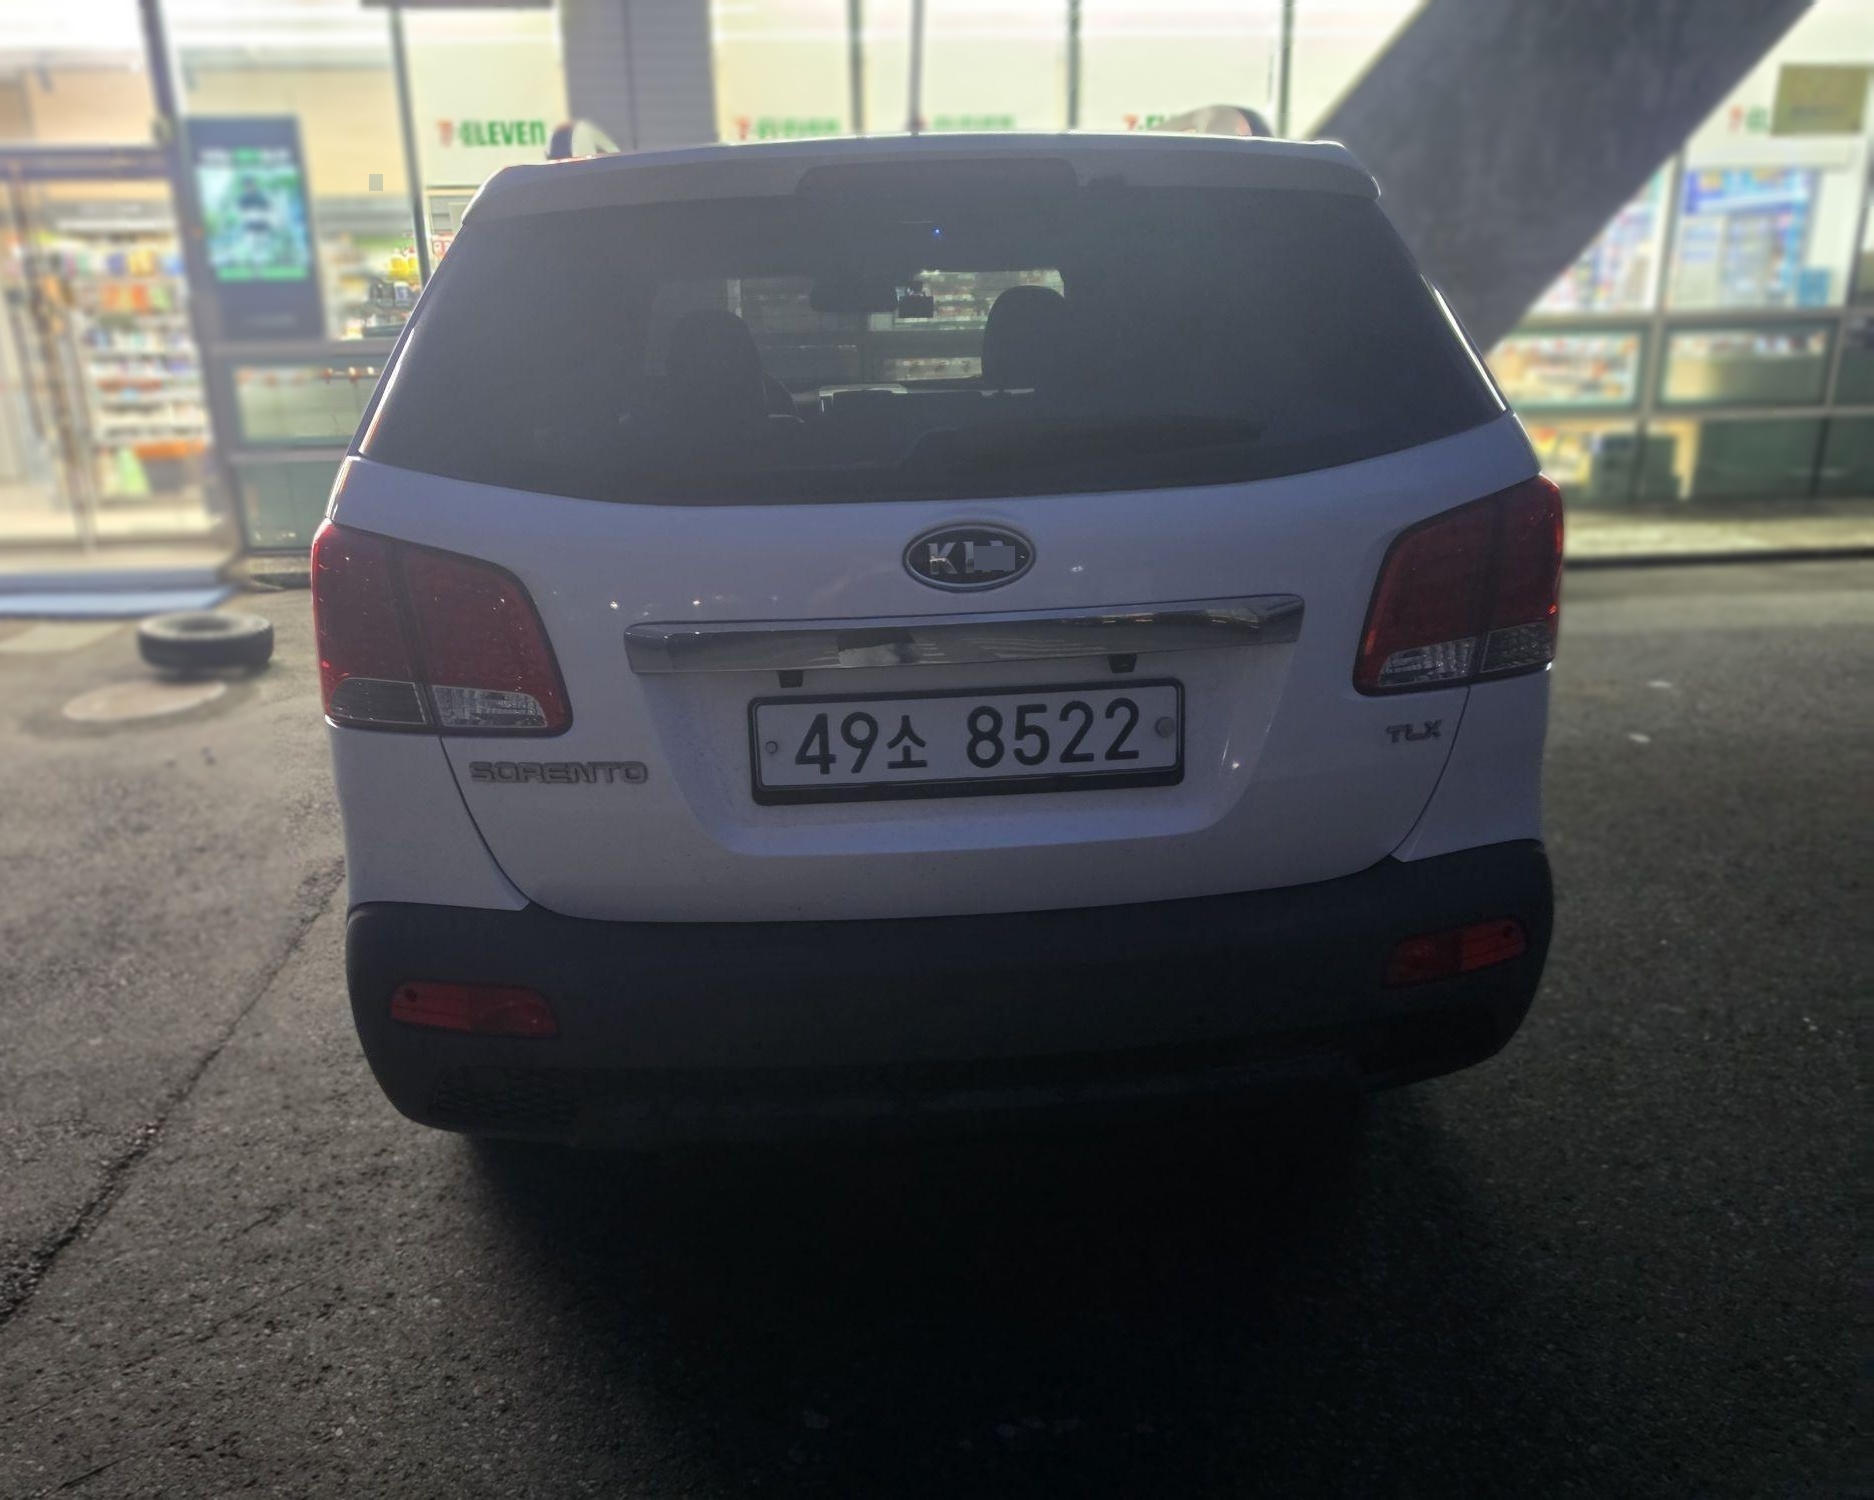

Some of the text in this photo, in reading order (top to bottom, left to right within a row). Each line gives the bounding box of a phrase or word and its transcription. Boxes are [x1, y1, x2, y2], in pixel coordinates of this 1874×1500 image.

[927, 540, 1015, 574] KI
[795, 697, 1140, 775] 49소 8522
[1386, 719, 1442, 744] TLX
[469, 761, 649, 784] SORENTO
